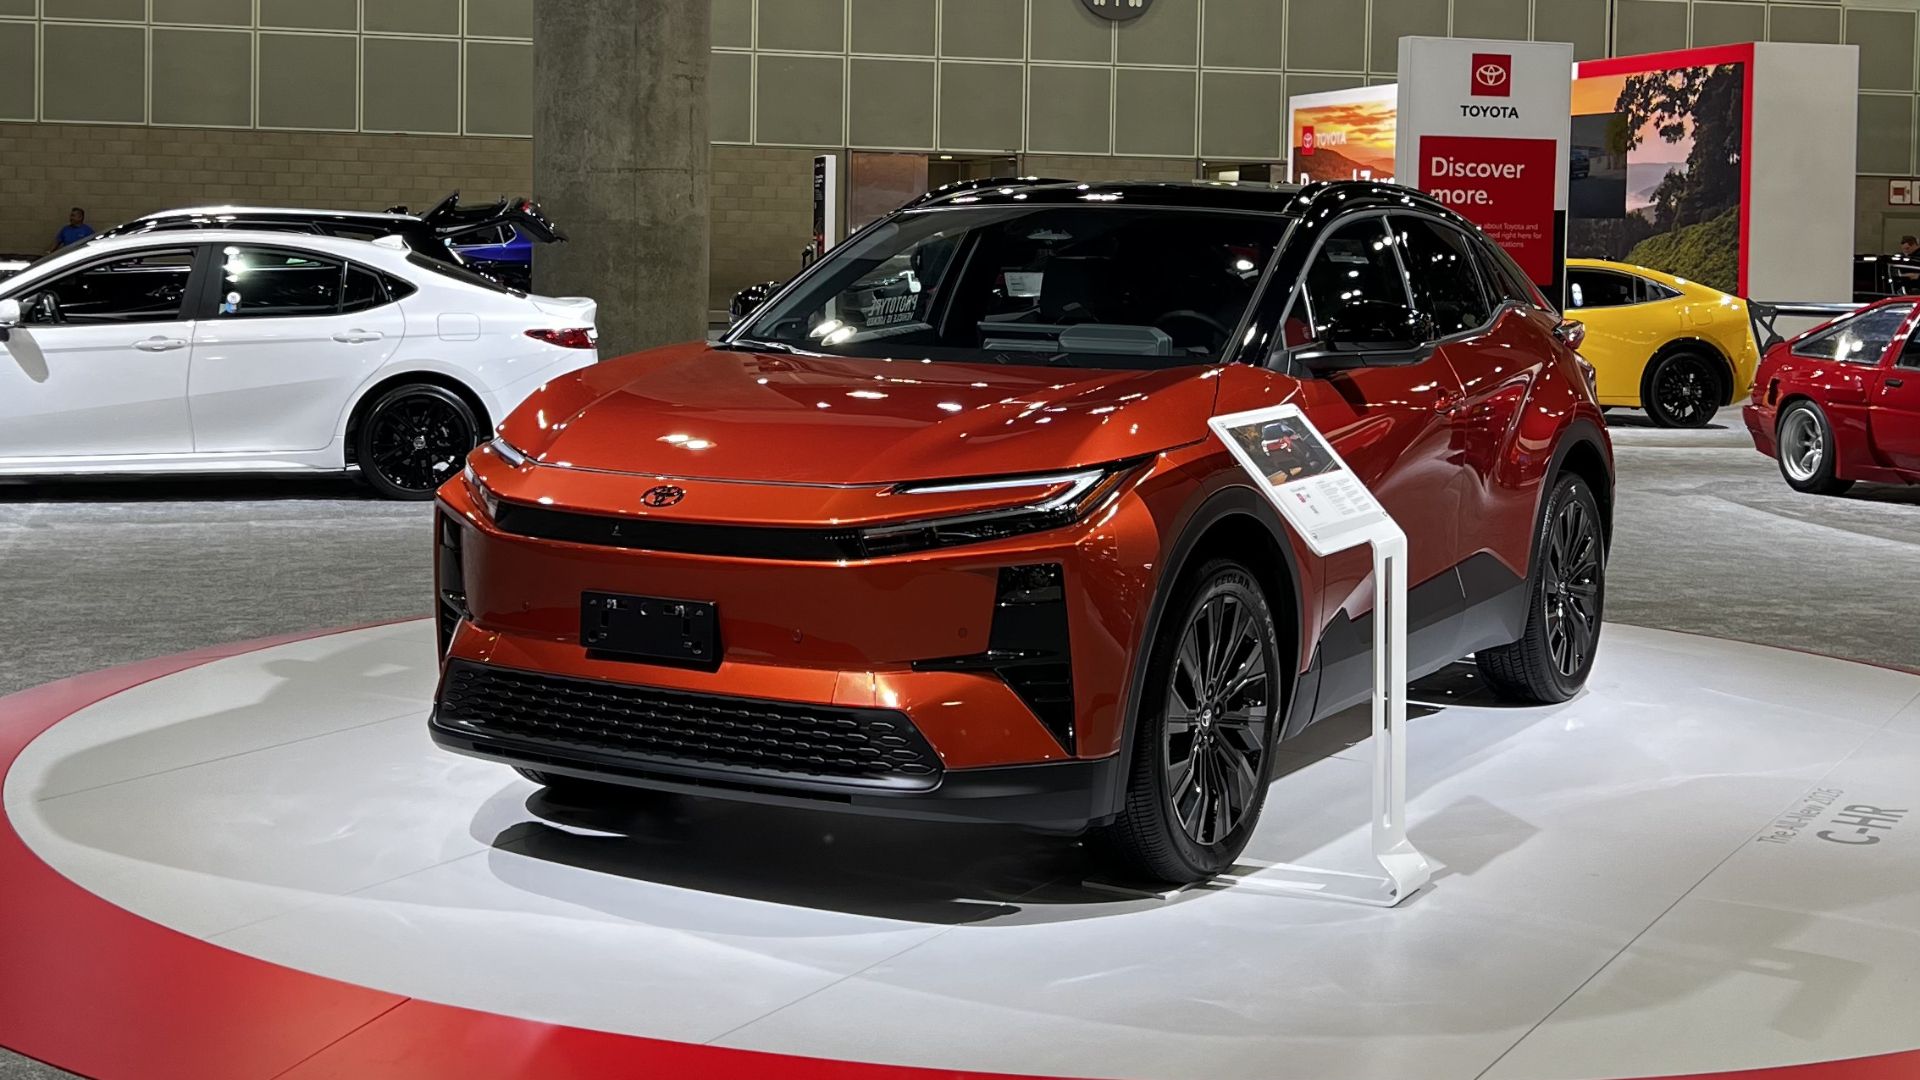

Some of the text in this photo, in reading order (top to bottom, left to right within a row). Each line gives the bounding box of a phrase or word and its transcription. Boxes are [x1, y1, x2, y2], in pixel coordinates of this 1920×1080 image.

[1460, 105, 1519, 119] TOYOTA
[1316, 132, 1347, 147] TOYOTA
[1431, 156, 1525, 179] Discover
[1430, 189, 1494, 205] more.
[1503, 222, 1524, 231] Toyota
[1501, 231, 1516, 240] right
[1517, 231, 1531, 239] here
[1532, 231, 1542, 239] for
[1816, 804, 1909, 845] C-HR
[1757, 830, 1797, 844] The
